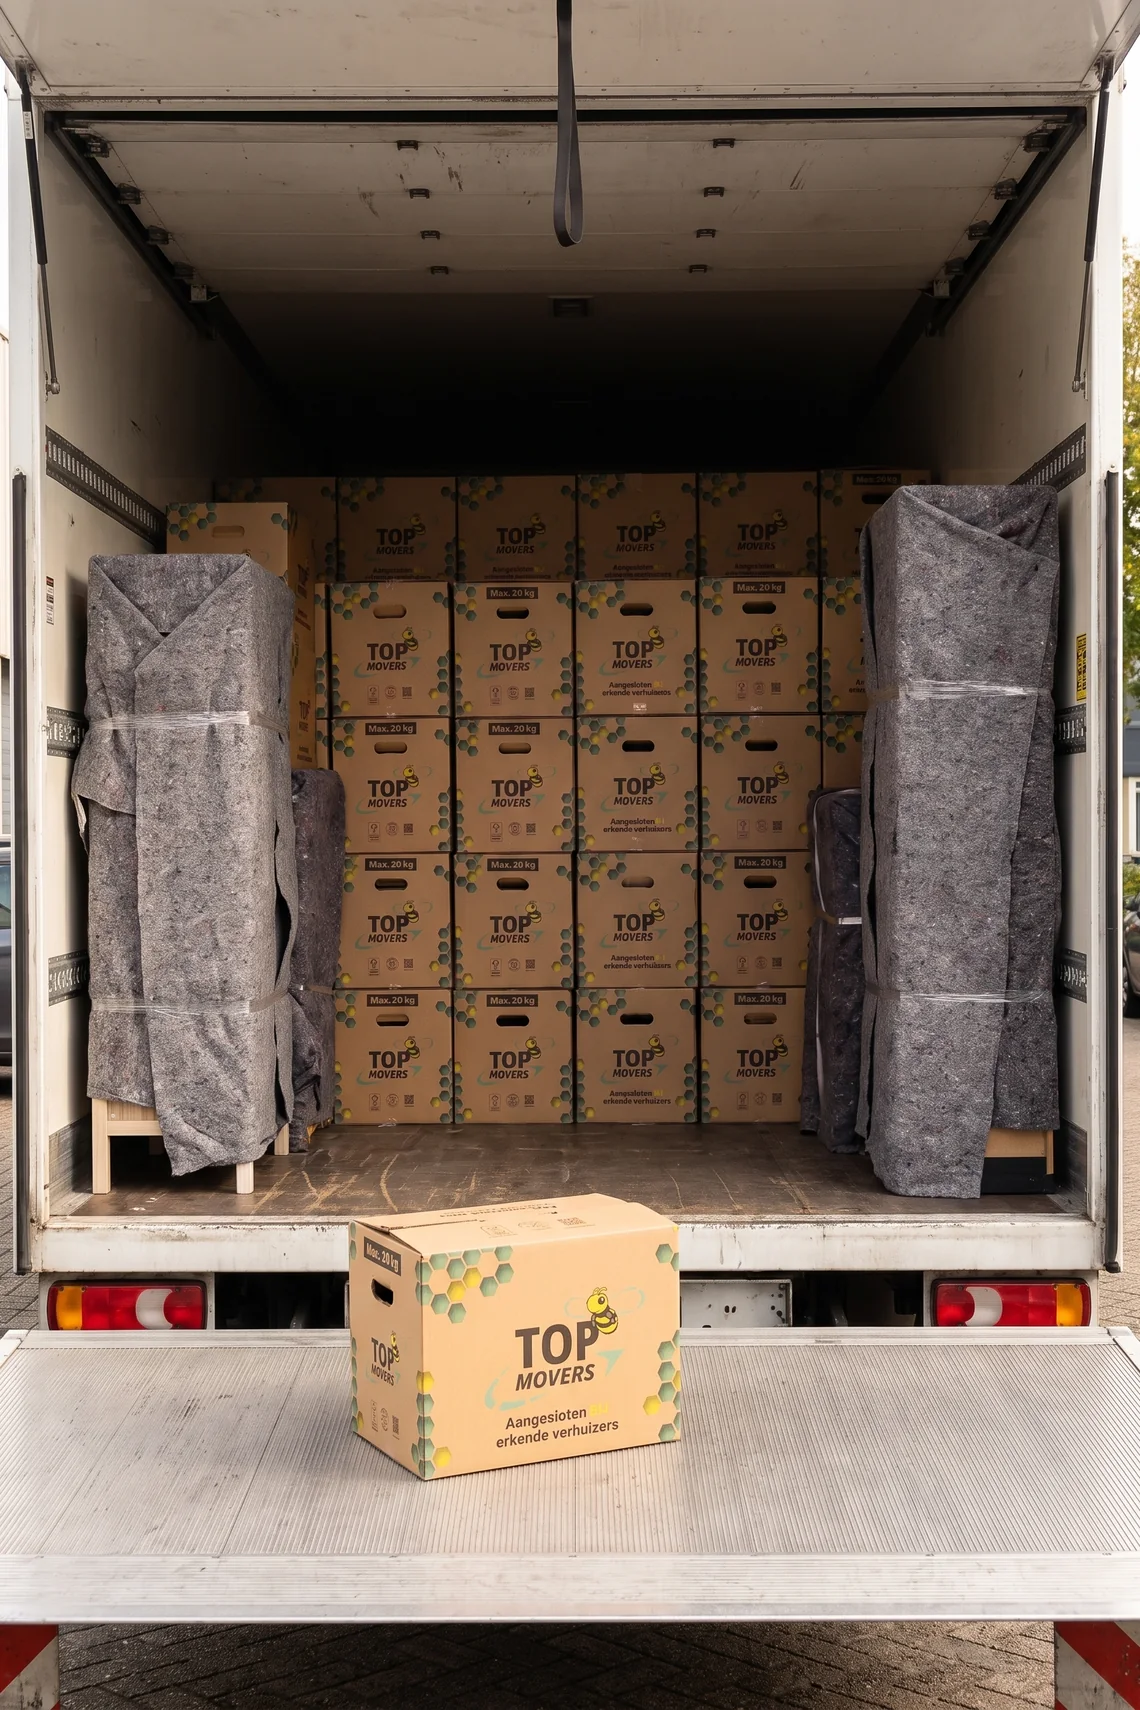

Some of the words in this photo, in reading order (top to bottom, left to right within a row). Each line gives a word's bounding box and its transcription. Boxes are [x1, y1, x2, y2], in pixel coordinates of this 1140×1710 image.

[497, 528, 535, 544] TOP
[617, 526, 656, 542] TOP
[738, 524, 777, 540] TOP
[376, 529, 415, 545] TOP
[496, 546, 534, 554] MOVERS
[616, 544, 654, 552] MOVERS
[738, 542, 775, 550] MOVERS
[772, 584, 782, 592] kg
[491, 589, 510, 597] Max.
[512, 589, 523, 597] 20
[525, 589, 535, 598] kg
[367, 643, 408, 660] TOP
[613, 641, 654, 658] TOP
[736, 639, 777, 656] TOP
[490, 644, 531, 661] TOP
[367, 662, 406, 670] MOVERS
[612, 659, 652, 668] MOVERS
[736, 658, 775, 666] MOVERS
[490, 663, 530, 671] MOVERS
[403, 725, 413, 733] kg
[526, 725, 536, 734] kg
[368, 780, 408, 797] TOP
[492, 780, 532, 797] TOP
[614, 778, 655, 794] TOP
[738, 777, 778, 793] TOP
[368, 799, 407, 807] MOVERS
[491, 799, 530, 807] MOVERS
[614, 796, 653, 805] MOVERS
[738, 795, 777, 804] MOVERS
[610, 818, 655, 826] Aangesloten
[403, 861, 413, 869] kg
[525, 861, 535, 870] kg
[773, 859, 783, 868] kg
[368, 916, 409, 932] TOP
[490, 916, 531, 933] TOP
[614, 914, 655, 931] TOP
[737, 914, 778, 930] TOP
[368, 934, 407, 942] MOVERS
[490, 934, 530, 943] MOVERS
[613, 933, 653, 941] MOVERS
[737, 932, 776, 941] MOVERS
[404, 996, 415, 1005] kg
[524, 997, 535, 1006] kg
[772, 995, 783, 1004] kg
[369, 1052, 410, 1068] TOP
[490, 1052, 531, 1068] TOP
[613, 1050, 654, 1067] TOP
[737, 1050, 778, 1067] TOP
[369, 1070, 408, 1079] MOVERS
[490, 1070, 529, 1079] MOVERS
[613, 1069, 652, 1077] MOVERS
[737, 1069, 776, 1077] MOVERS
[382, 1251, 390, 1265] 20
[515, 1321, 599, 1368] TOP
[371, 1338, 394, 1371] TOP
[371, 1363, 394, 1386] MOVERS
[516, 1364, 595, 1391] MOVERS
[496, 1430, 548, 1448] erkende
[553, 1421, 619, 1438] verhuizers
